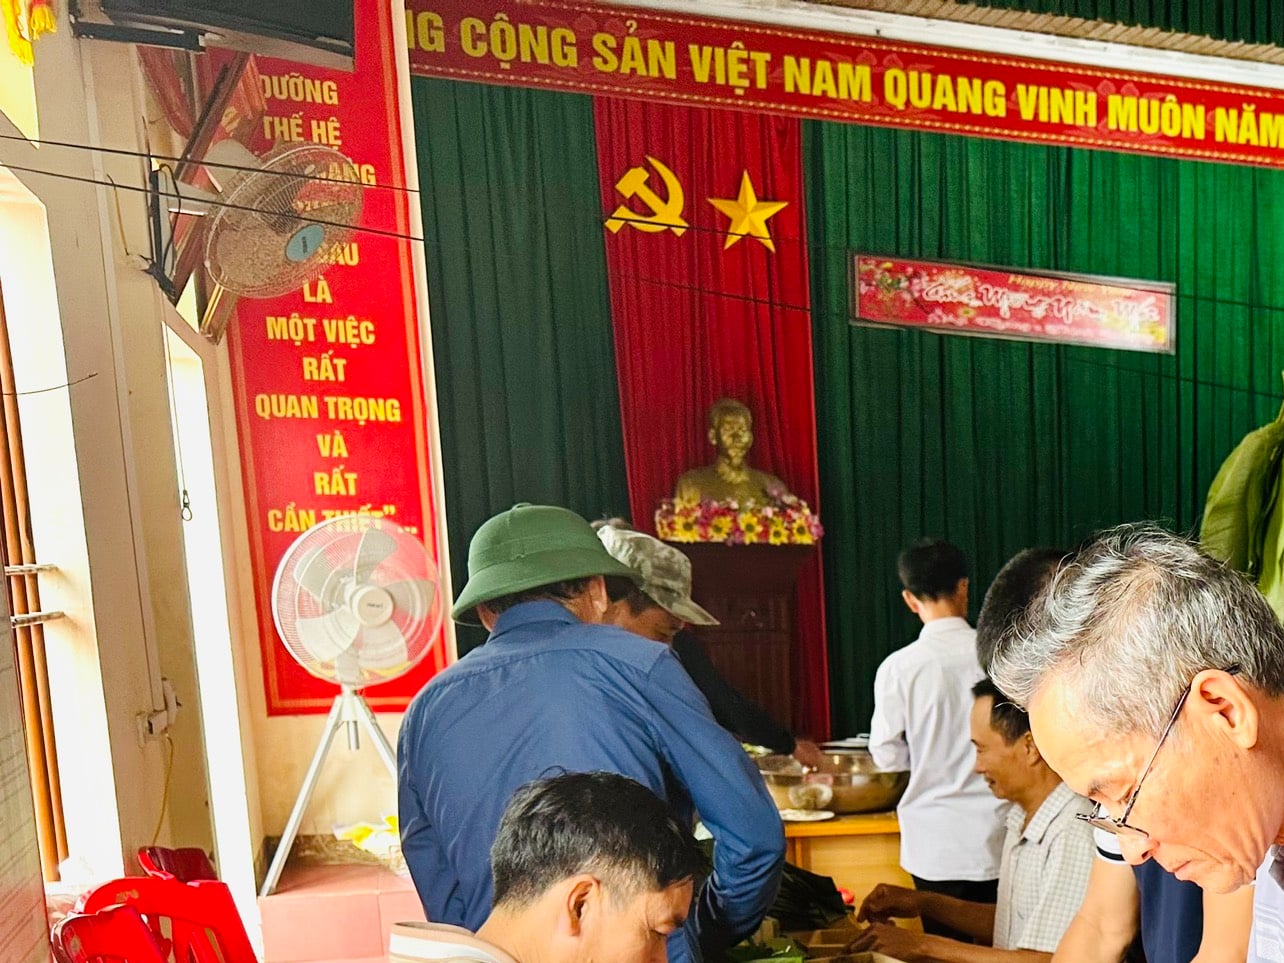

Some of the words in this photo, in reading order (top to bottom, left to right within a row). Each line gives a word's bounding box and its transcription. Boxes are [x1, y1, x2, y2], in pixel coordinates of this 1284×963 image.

[459, 13, 578, 70] CỘNG
[592, 19, 677, 80] SẢN
[688, 40, 772, 95] VIỆT
[783, 55, 872, 103] NAM
[884, 68, 1006, 117] QUANG
[1016, 83, 1098, 127] VINH
[1107, 94, 1206, 140] MUÔN
[263, 112, 304, 141] THẾ
[311, 117, 342, 150] HỆ
[303, 275, 333, 304] LÀ
[265, 312, 316, 346] MỘT
[323, 316, 376, 349] VIỆC
[303, 350, 347, 381] RẤT
[255, 394, 318, 420] QUAN
[324, 396, 401, 425] TRỌNG
[316, 430, 348, 458] VÀ
[313, 465, 357, 496] RẤT
[267, 502, 316, 533] CẦN
